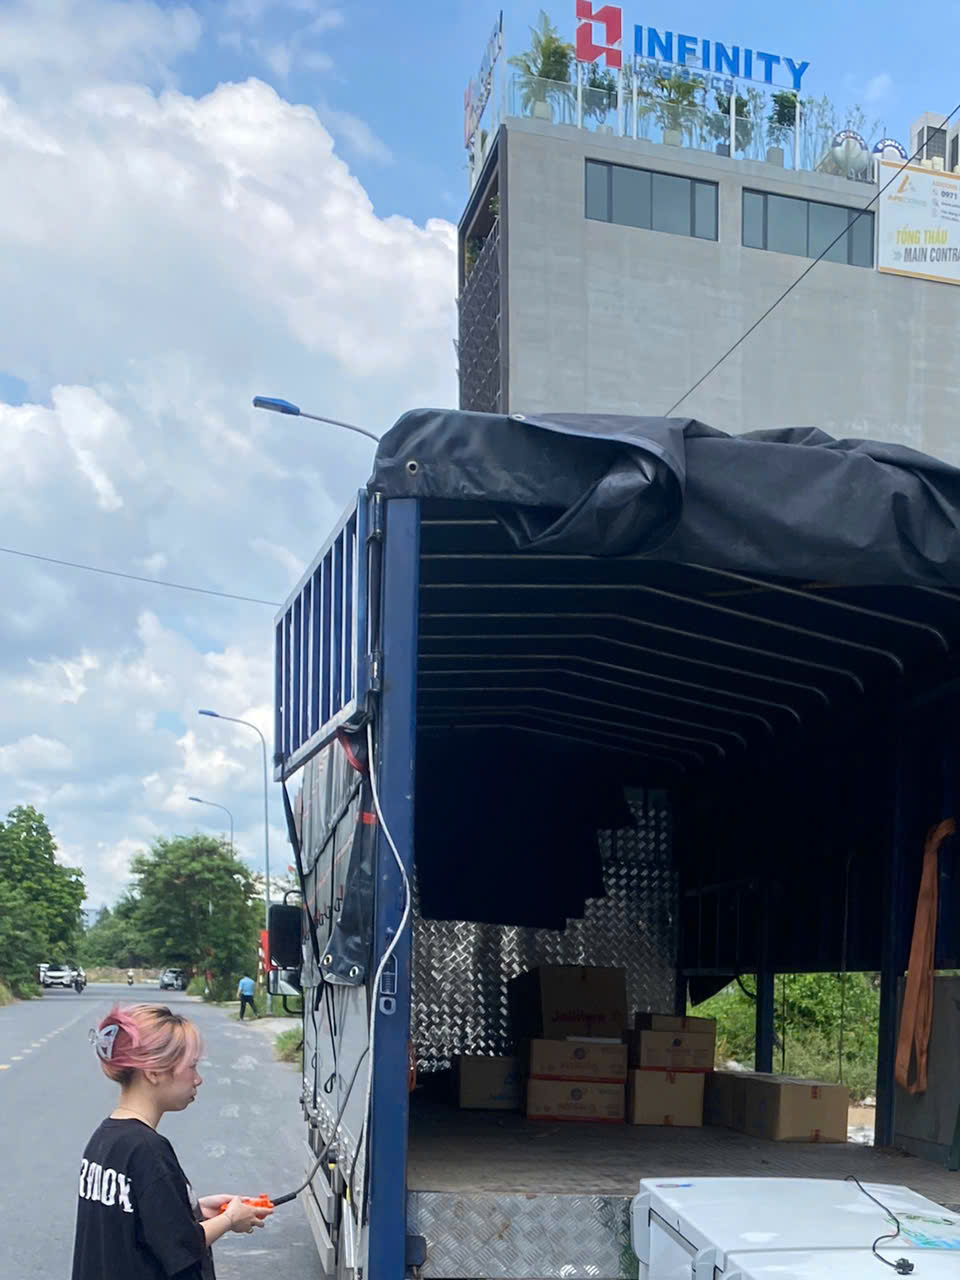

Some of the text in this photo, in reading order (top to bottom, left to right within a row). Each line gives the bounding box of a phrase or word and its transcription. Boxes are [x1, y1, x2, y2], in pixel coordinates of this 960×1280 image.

[633, 24, 811, 91] INFINITY
[941, 190, 958, 202] 0971
[904, 247, 928, 263] MAIN
